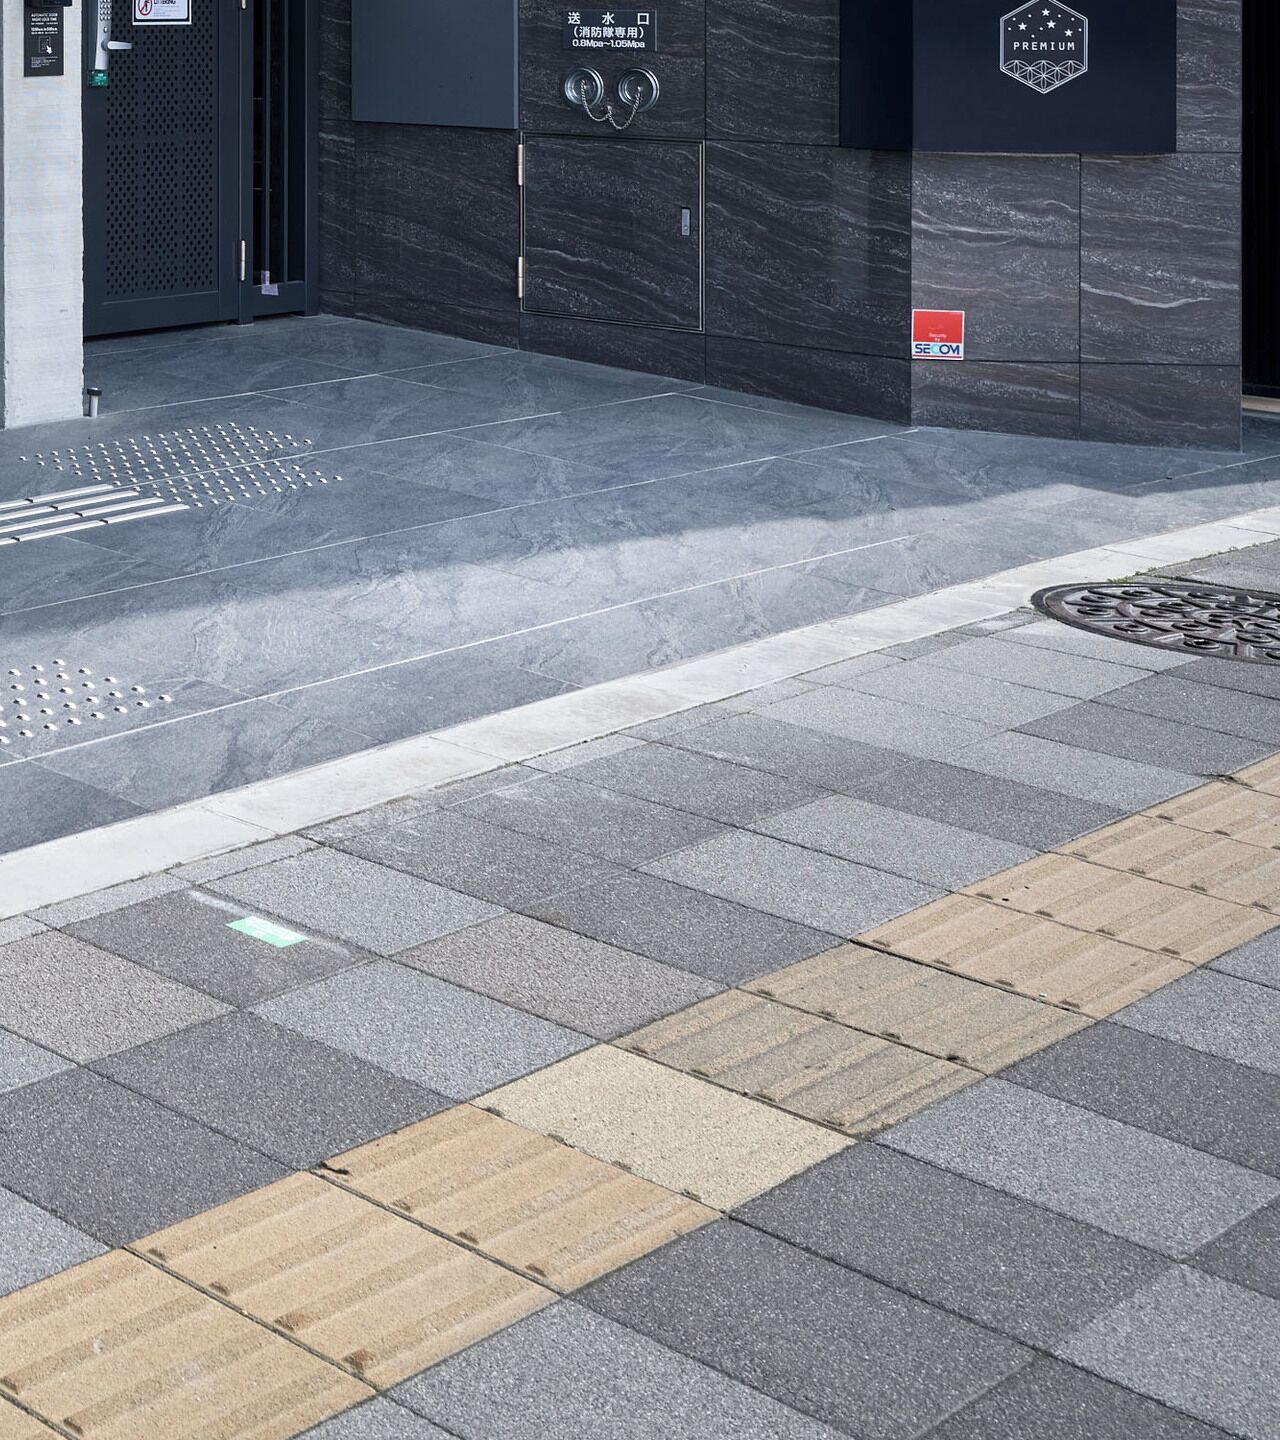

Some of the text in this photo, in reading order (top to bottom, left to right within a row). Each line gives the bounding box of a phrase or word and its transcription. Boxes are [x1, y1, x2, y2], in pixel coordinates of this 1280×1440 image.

[568, 12, 650, 25] 送水口
[1013, 41, 1076, 51] PREMIUM
[915, 343, 960, 355] SECOM
